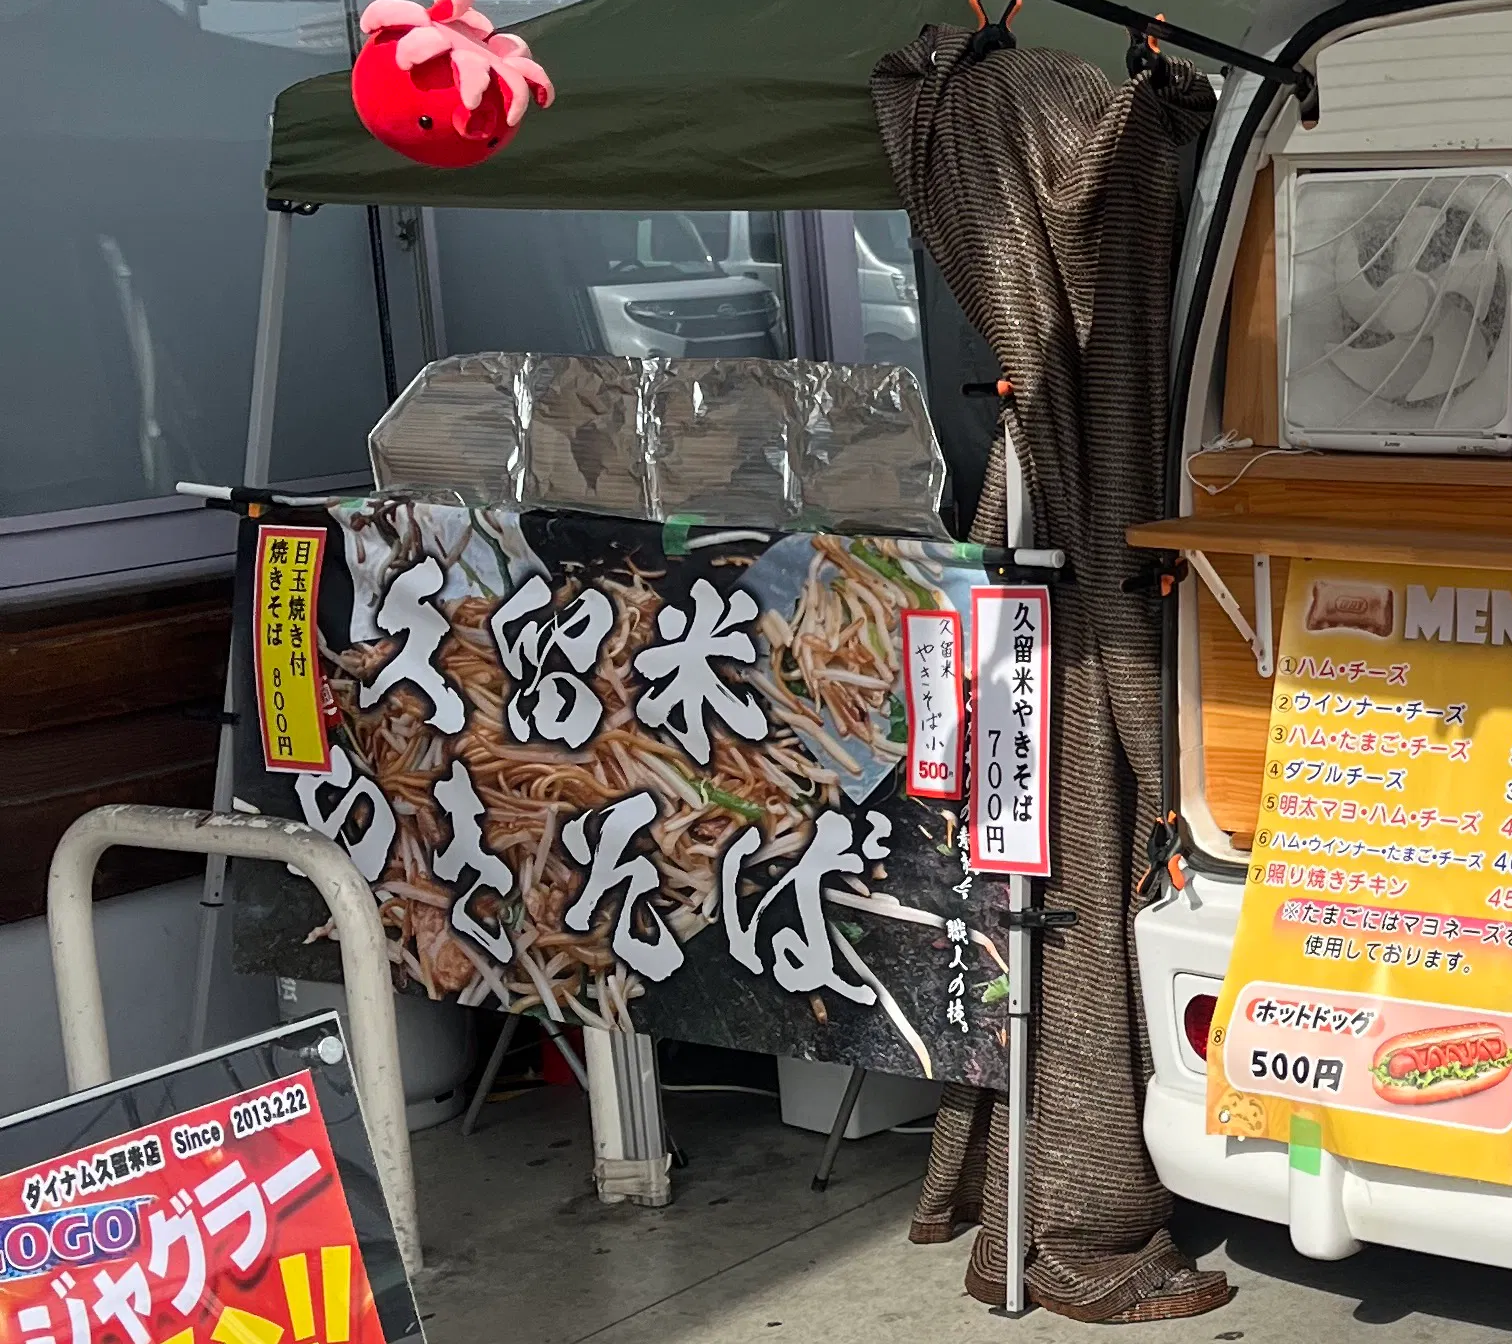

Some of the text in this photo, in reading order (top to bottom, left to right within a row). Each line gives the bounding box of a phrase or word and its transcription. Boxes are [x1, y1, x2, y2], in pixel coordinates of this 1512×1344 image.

[287, 540, 312, 677] 目玉焼き付
[266, 538, 293, 757] 焼きそば 800円
[358, 556, 770, 766] 久留米
[938, 617, 956, 679] 久留米
[1012, 601, 1036, 823] 久留米やきそば
[986, 729, 1006, 855] 700円
[1303, 934, 1473, 974] 使用しております。
[1255, 999, 1375, 1036] ホットドッグ
[1250, 1049, 1345, 1093] 500円
[173, 1124, 222, 1155] Since
[233, 1087, 307, 1134] 2013.2.22
[0, 1205, 138, 1275] OGO
